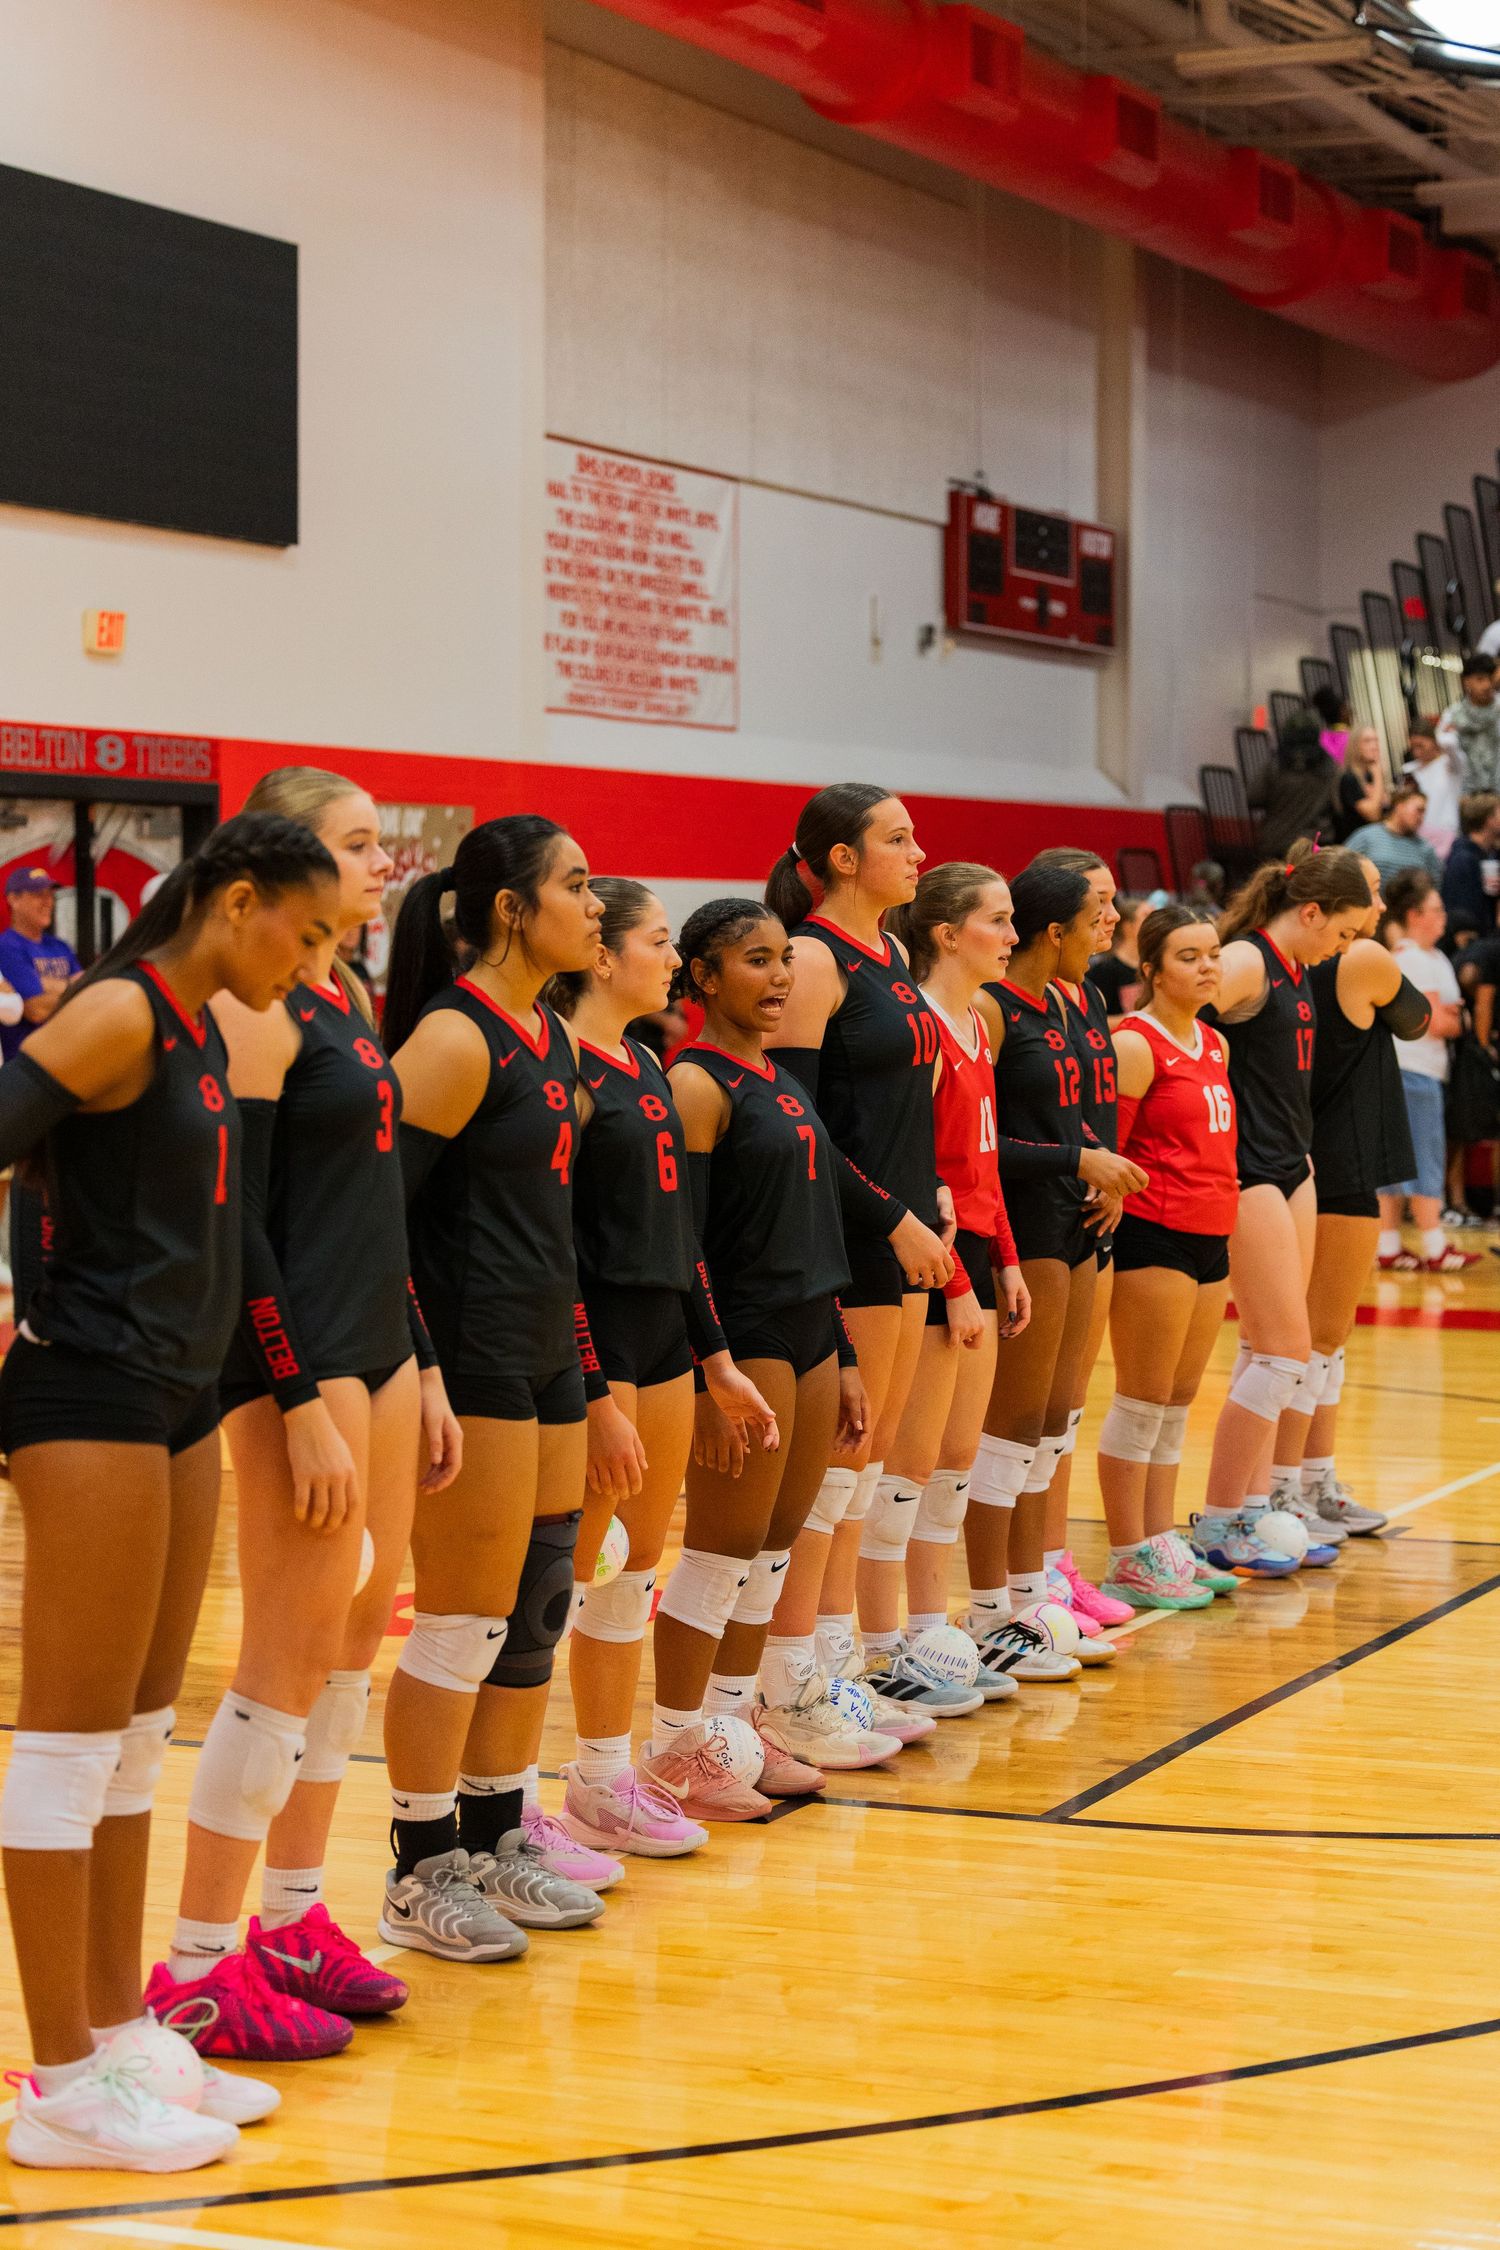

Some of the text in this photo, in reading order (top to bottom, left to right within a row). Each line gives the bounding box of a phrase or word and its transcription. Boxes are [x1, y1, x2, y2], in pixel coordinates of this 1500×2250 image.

[0, 726, 86, 769] BELTON
[132, 736, 211, 777] TIGERS
[907, 1012, 936, 1066] 10
[1296, 1028, 1313, 1071] 17
[1054, 1056, 1080, 1107] 12
[1093, 1057, 1116, 1104] 15
[375, 1080, 393, 1152] 3
[1202, 1084, 1231, 1133] 16
[214, 1125, 229, 1205] 1
[550, 1122, 573, 1185] 4
[656, 1131, 678, 1192] 6
[796, 1125, 817, 1180] 7
[247, 1296, 300, 1379] BELTON
[711, 1752, 731, 1768] OUT
